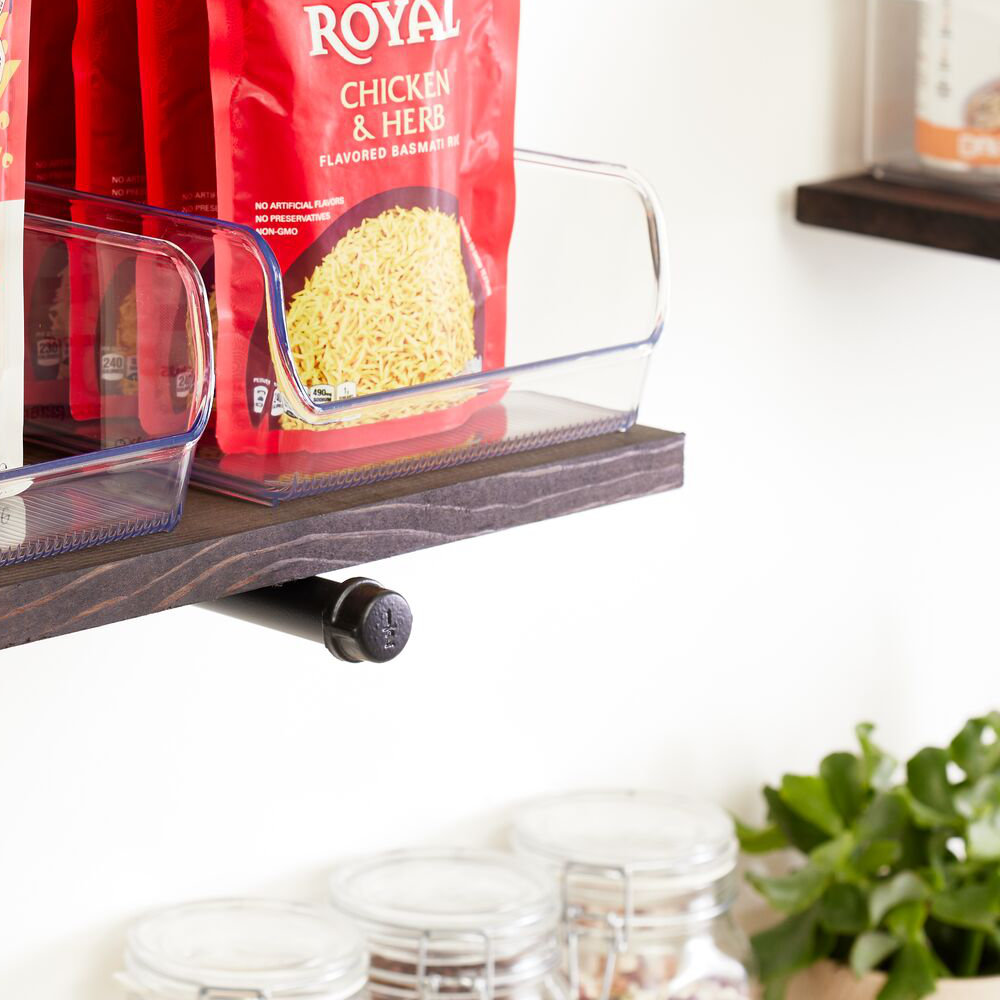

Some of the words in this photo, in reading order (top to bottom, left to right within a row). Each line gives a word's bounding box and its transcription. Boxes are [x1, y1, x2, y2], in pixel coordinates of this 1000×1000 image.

[340, 69, 450, 109] CHICKEN
[353, 115, 376, 142] &
[382, 103, 446, 138] HERB
[319, 146, 387, 168] FLAVORED
[391, 138, 445, 158] BASMATI
[255, 202, 268, 211] NO
[269, 199, 313, 211] ARTIFICIAL
[314, 197, 345, 209] FLAVORS
[255, 214, 268, 223] NO
[269, 212, 331, 223] PRESERVATIVES
[255, 226, 298, 236] NON-GMO
[103, 357, 123, 369] 240
